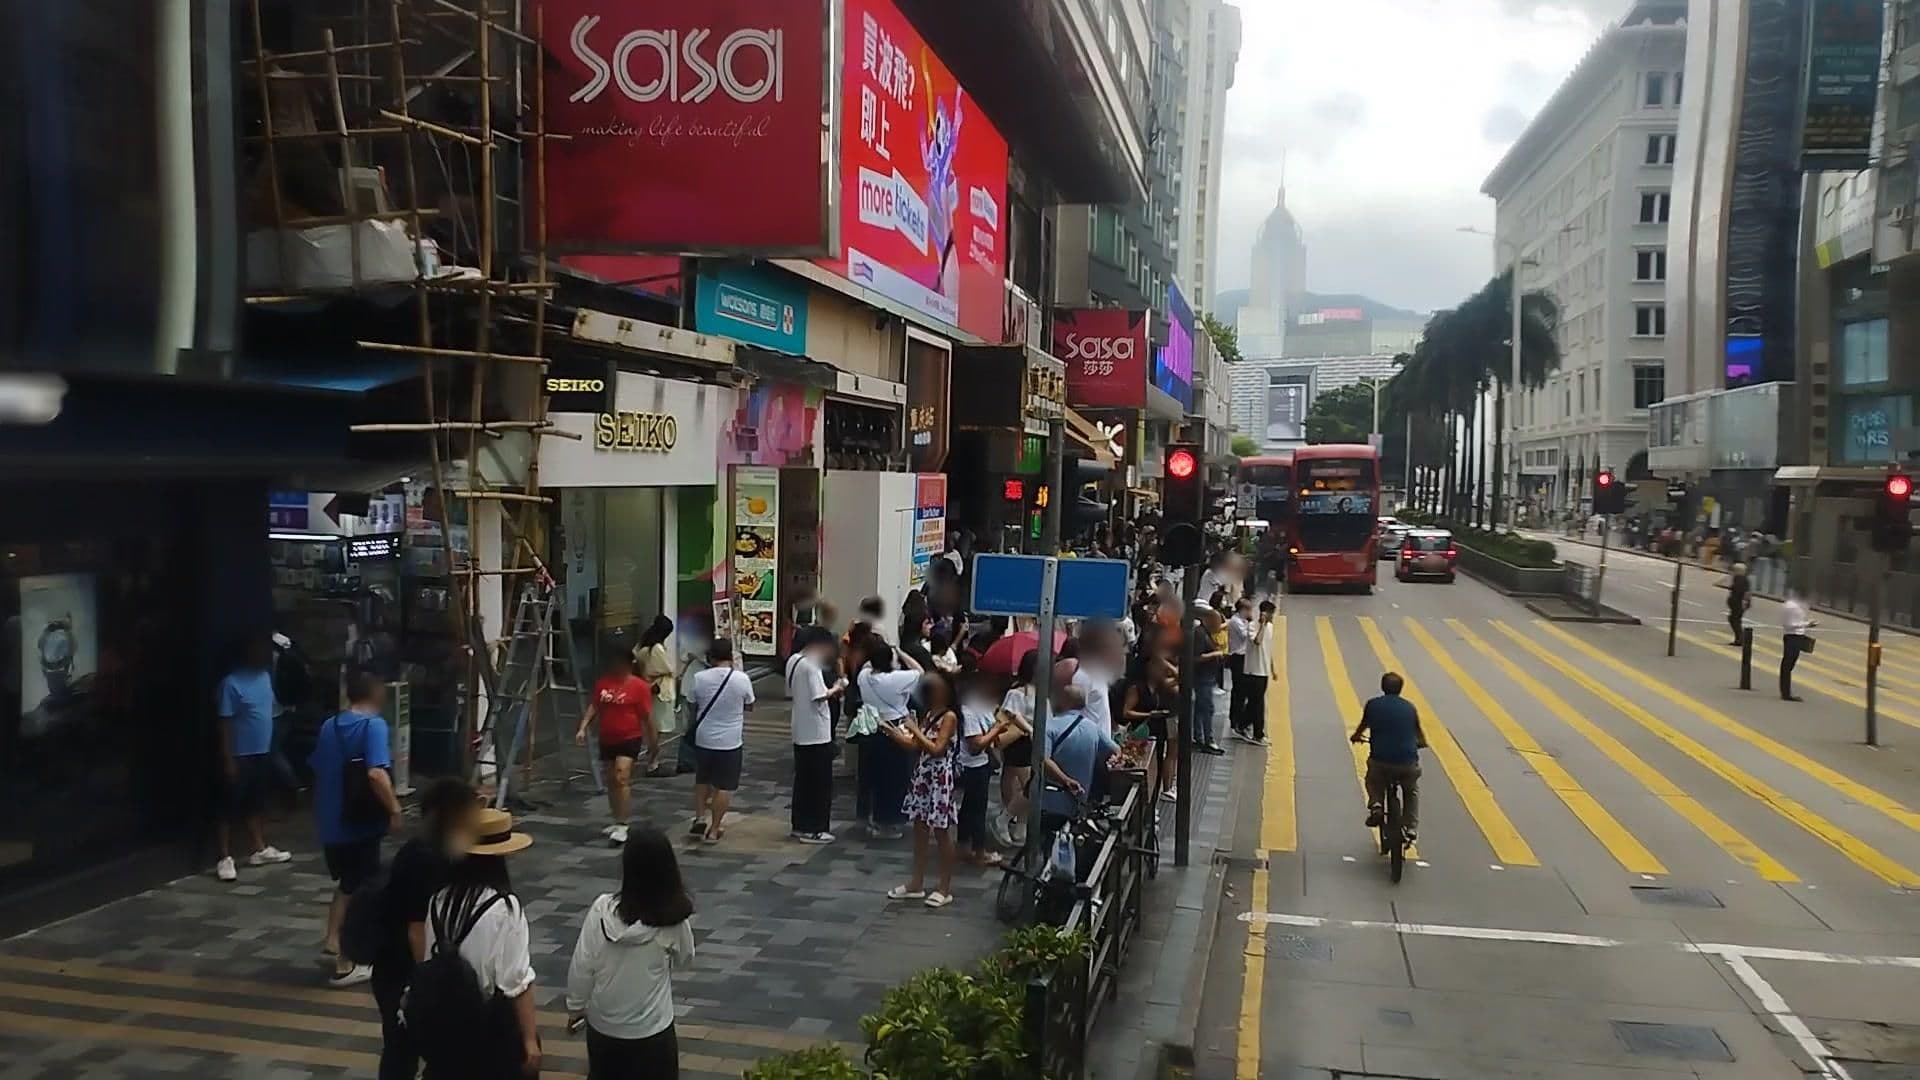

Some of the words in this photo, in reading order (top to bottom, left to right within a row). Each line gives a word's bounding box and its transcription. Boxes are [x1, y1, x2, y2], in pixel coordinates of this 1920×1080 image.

[582, 121, 643, 147] making
[648, 114, 683, 146] life
[688, 113, 771, 147] beautiful
[861, 83, 890, 161] 即上
[862, 180, 893, 217] more
[895, 182, 925, 242] tickets
[546, 379, 604, 392] SEIKO
[1083, 360, 1114, 376] 莎莎
[597, 411, 677, 450] SEIKO
